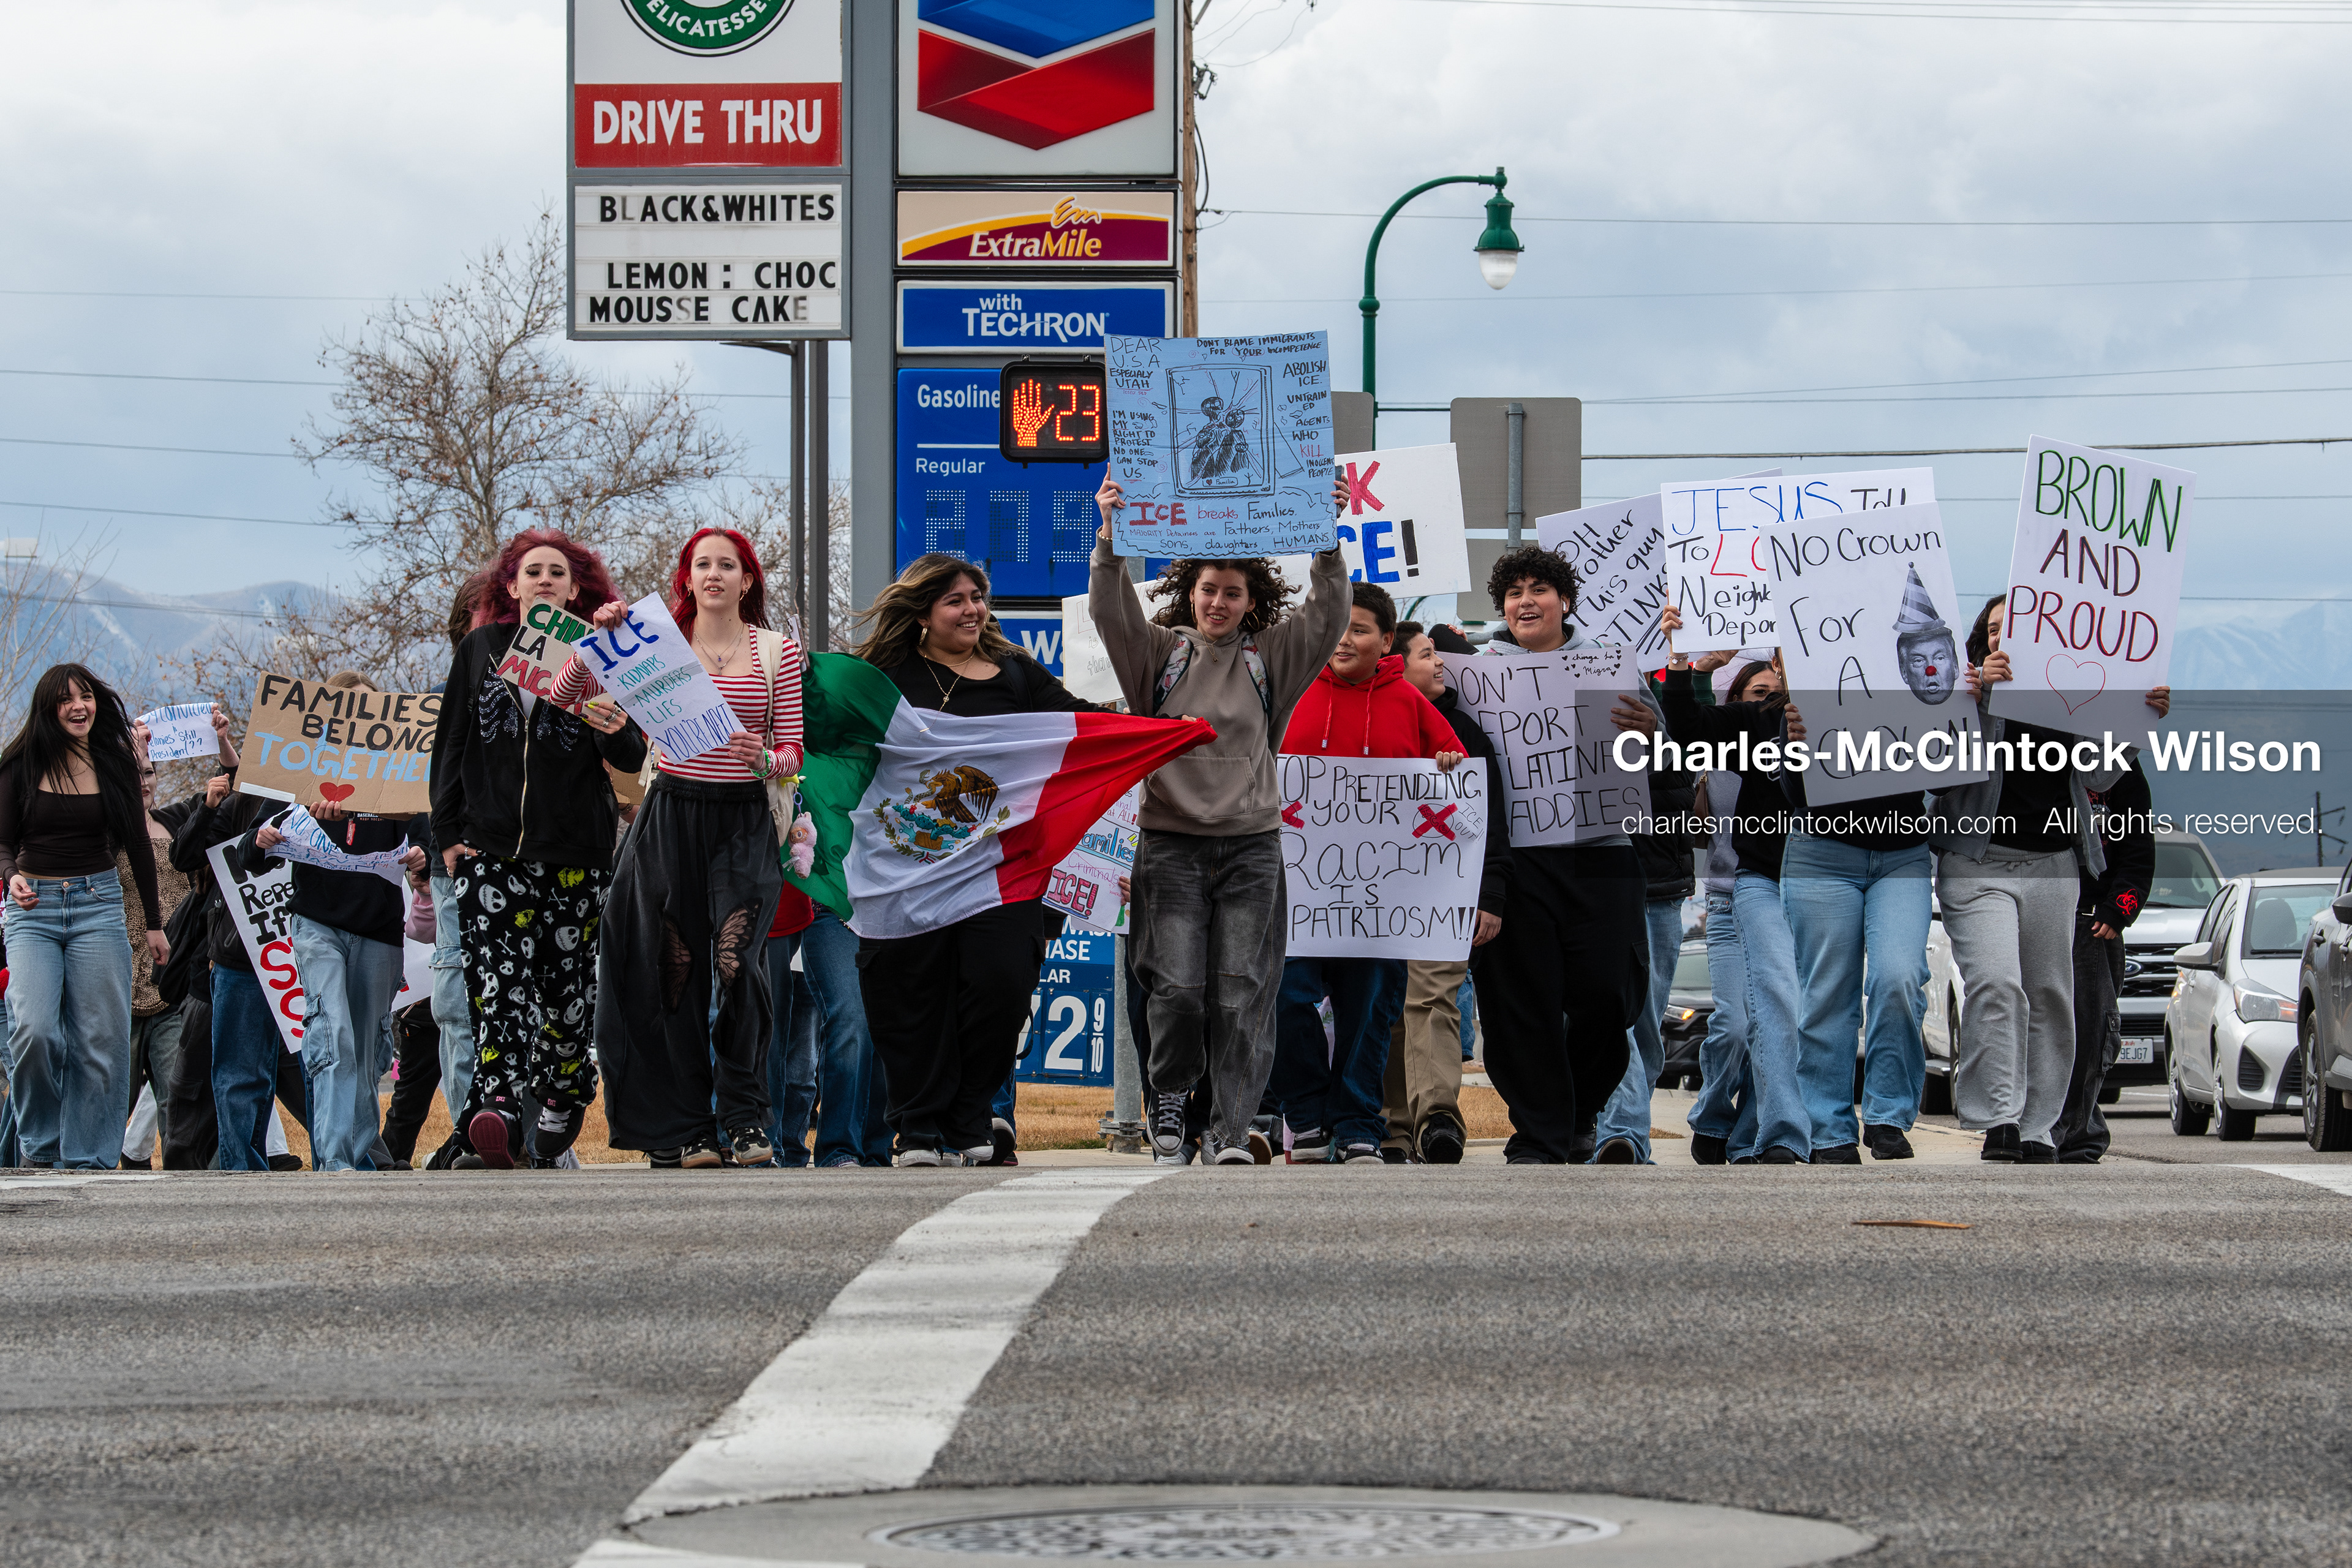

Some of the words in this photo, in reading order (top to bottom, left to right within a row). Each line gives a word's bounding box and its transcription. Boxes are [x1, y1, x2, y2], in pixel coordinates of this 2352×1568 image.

[647, 0, 771, 37] ELICATESSE
[594, 100, 704, 146] DRIVE
[720, 99, 822, 144] THRU
[600, 195, 834, 222] BLACK&WHITES
[969, 229, 1102, 258] ExtraMile
[607, 262, 707, 289] LEMON
[754, 262, 836, 288] CHOC
[589, 296, 709, 323] MOUSSE
[731, 295, 807, 323] CAKE
[979, 293, 1022, 311] with
[1111, 337, 1162, 354] DEAR
[1224, 337, 1254, 347] BLAME
[1259, 332, 1316, 345] IMMIGRANTS
[1235, 347, 1262, 356] YOUR
[1112, 354, 1161, 368] U.S.A
[1283, 360, 1327, 378] ABOLISH
[1115, 379, 1150, 389] UTAH
[1298, 375, 1322, 386] ICE.
[918, 384, 1000, 409] Gasoline
[1287, 390, 1327, 404] UNTRAIN
[1303, 402, 1315, 411] ED
[1056, 384, 1100, 442] 23
[1112, 420, 1128, 429] MY
[1113, 410, 1126, 419] I'M
[1130, 412, 1155, 421] USING
[1292, 430, 1319, 441] WHO
[1114, 447, 1126, 455] NO
[1137, 458, 1158, 467] STOP
[1300, 443, 1324, 458] KILL
[916, 458, 986, 477] Regular
[1129, 502, 1188, 526] ICE
[1197, 505, 1239, 520] breaks
[1671, 481, 1843, 535] JESUS
[2035, 450, 2182, 552] BROWN
[1129, 529, 1163, 538] MAJORITY
[1278, 521, 1321, 533] Mothers
[1337, 519, 1419, 583] CE!
[1575, 510, 1634, 585] rother
[1667, 535, 1709, 563] To
[1770, 532, 1830, 581] NO
[1837, 527, 1942, 562] Crown
[2040, 528, 2141, 597] AND
[1790, 597, 1864, 657] For
[2007, 585, 2158, 662] PROUD
[511, 625, 547, 662] LA
[580, 609, 660, 672] ICE
[1088, 636, 1099, 649] is
[617, 654, 666, 691] KIDNAPS
[1583, 665, 1612, 676] Migra
[1839, 656, 1873, 706] A
[635, 666, 692, 707] MURDERS
[260, 674, 443, 728] FAMILIES
[647, 698, 682, 723] LIES
[148, 730, 175, 747] elonies
[301, 714, 436, 754] BELONG
[701, 703, 736, 747] NEXT
[1332, 766, 1482, 803] PRETENDING
[291, 804, 311, 835] NO
[1107, 807, 1116, 816] at
[1458, 802, 1483, 829] ICE
[1047, 869, 1099, 916] ICE!
[1327, 883, 1379, 907] IS
[249, 905, 290, 946] If
[1045, 939, 1091, 961] ASE
